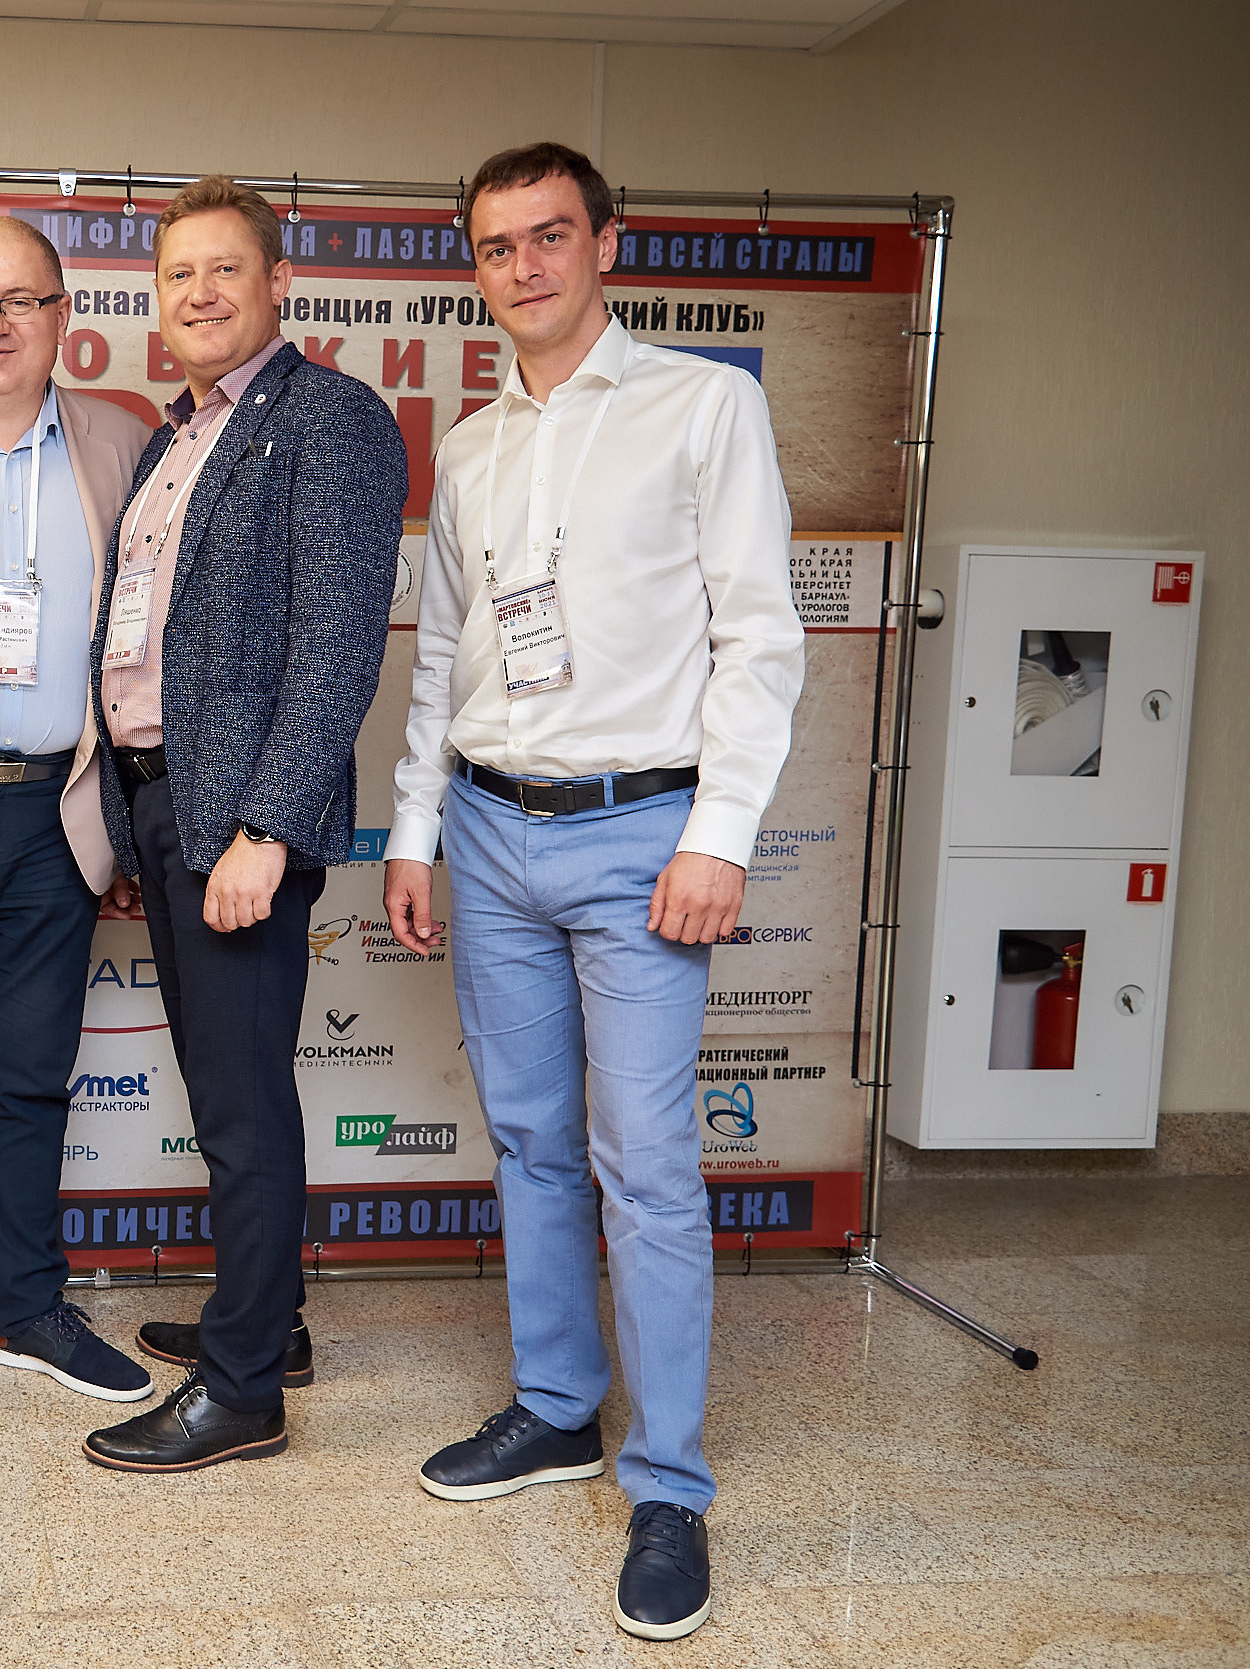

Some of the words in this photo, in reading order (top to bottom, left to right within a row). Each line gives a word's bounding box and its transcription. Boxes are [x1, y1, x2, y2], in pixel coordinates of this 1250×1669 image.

[648, 232, 725, 269] ВСЕЙ
[735, 238, 864, 273] СТРАНЫ
[280, 296, 393, 328] ренция
[676, 302, 764, 333] КЛУБ»
[809, 547, 853, 556] КРАЯ
[790, 558, 812, 567] ОГО
[820, 558, 852, 567] КРАЯ
[790, 569, 851, 579] ЬНИЦА
[791, 581, 851, 589] ВЕРСИТЕТ
[539, 600, 556, 609] 2021
[801, 603, 850, 612] УРОЛОГОВ
[497, 606, 532, 622] ВСТРЕЧИ
[800, 614, 849, 623] ОЛОГИЯМ
[756, 826, 836, 842] СТОЧНЫЙ
[753, 845, 800, 857] ЛЬЯНС
[747, 864, 799, 873] дицинская
[747, 874, 782, 882] мпания
[705, 1007, 763, 1018] кционерное
[765, 1007, 811, 1018] общество
[295, 1045, 394, 1059] VOLKMANN
[698, 1046, 789, 1063] РАТЕГИЧЕСКИЙ
[696, 1065, 768, 1083] АЦИОННЫЙ
[773, 1066, 826, 1080] ПАРТНЕР
[341, 1121, 386, 1141] уро
[386, 1127, 455, 1150] лайф
[702, 1139, 758, 1154] UroWeb
[698, 1158, 780, 1170] w.uroweb.ru
[329, 1198, 500, 1237] РЕВОЛЮ
